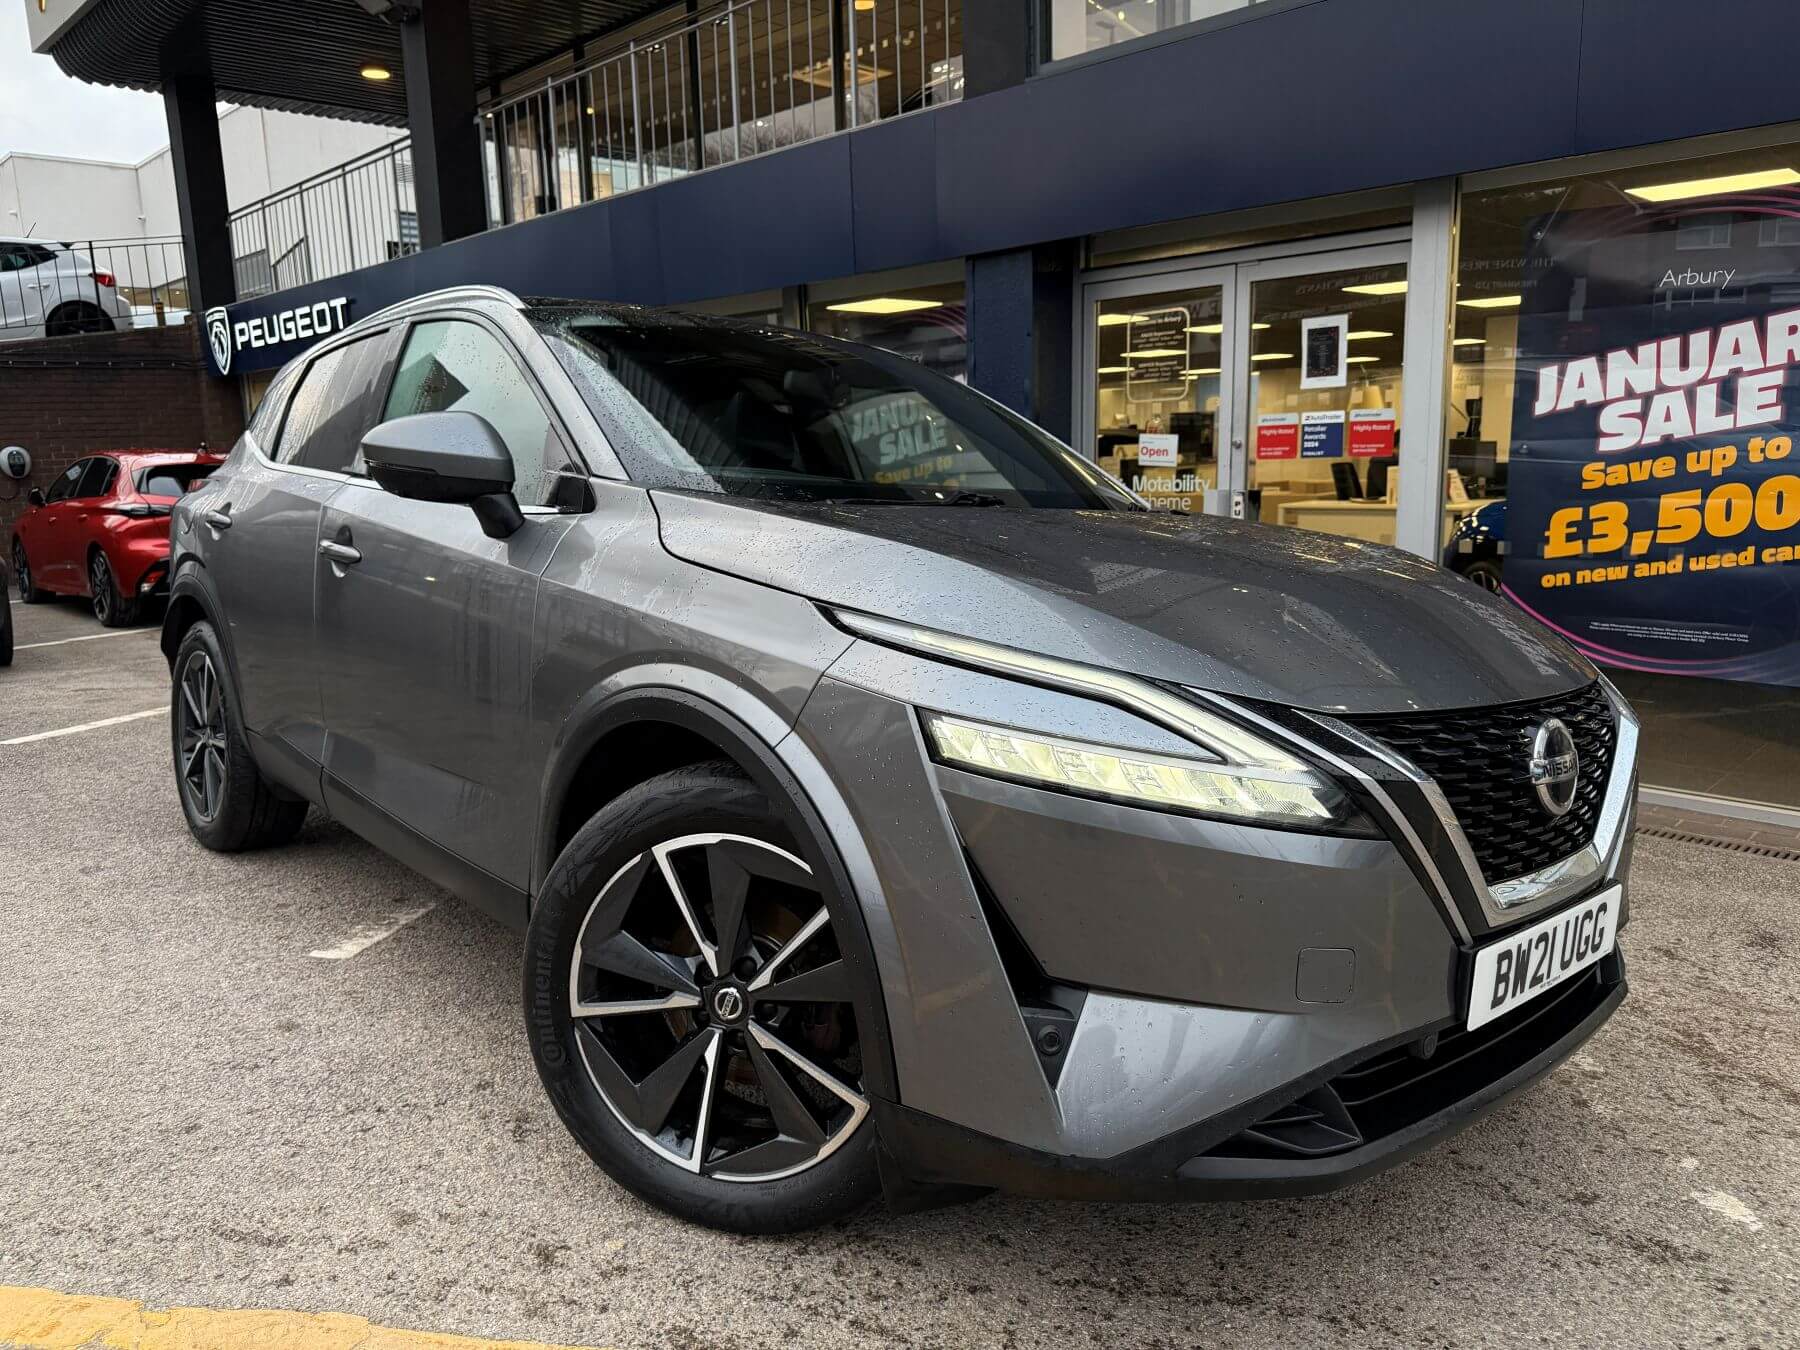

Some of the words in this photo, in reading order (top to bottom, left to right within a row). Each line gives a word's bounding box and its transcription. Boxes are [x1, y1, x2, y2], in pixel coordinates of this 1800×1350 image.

[1660, 267, 1736, 290] Arbury
[234, 297, 347, 350] PEUGEOT
[1535, 309, 1800, 416] JANUAR
[1599, 370, 1784, 451] SALE
[1140, 446, 1168, 458] Open
[1582, 456, 1676, 490] Save
[1687, 446, 1737, 477] up
[1747, 436, 1792, 463] to
[1132, 473, 1211, 493] Motability
[1144, 493, 1192, 511] heme
[1543, 475, 1800, 559] £3,500
[1541, 570, 1571, 588] on
[1576, 565, 1629, 584] new
[1634, 554, 1684, 578] and
[1689, 546, 1755, 571] used
[1761, 545, 1800, 564] ca
[1490, 926, 1558, 1010] BW21
[1560, 902, 1608, 972] UGG
